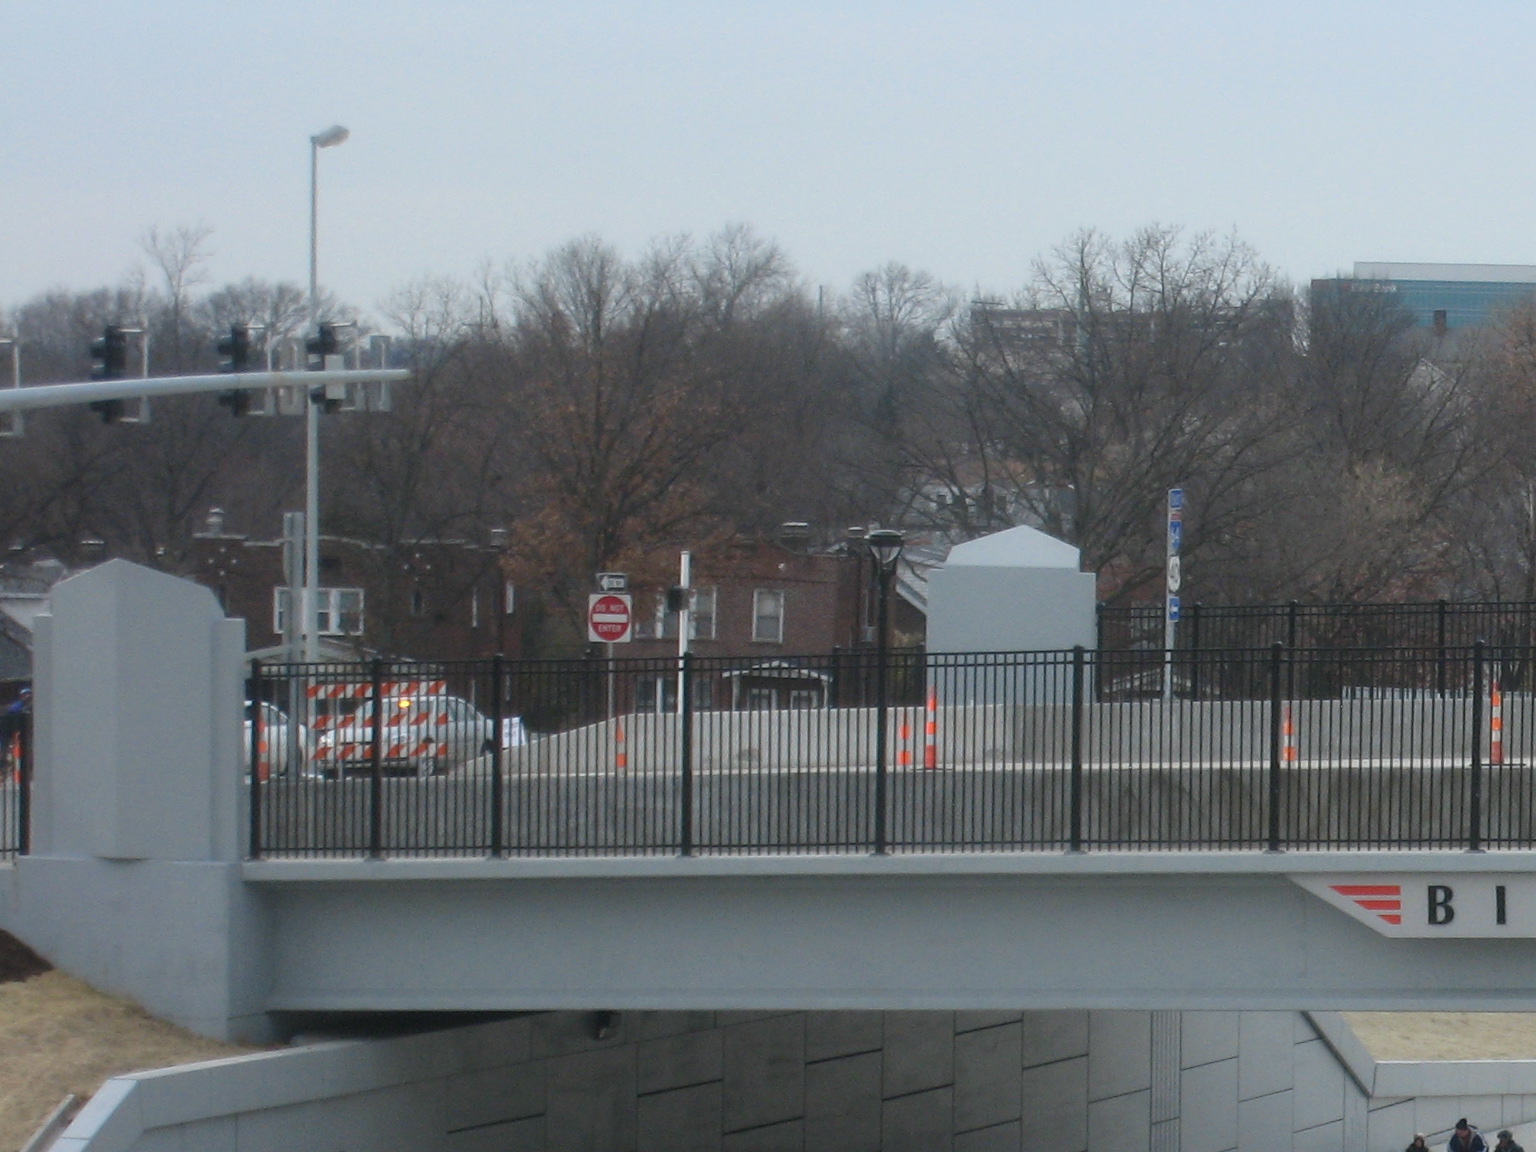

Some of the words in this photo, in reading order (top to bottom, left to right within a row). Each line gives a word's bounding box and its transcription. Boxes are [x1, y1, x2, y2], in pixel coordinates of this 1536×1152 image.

[595, 604, 606, 612] DO
[610, 604, 625, 612] NOT
[599, 624, 621, 632] ENTER
